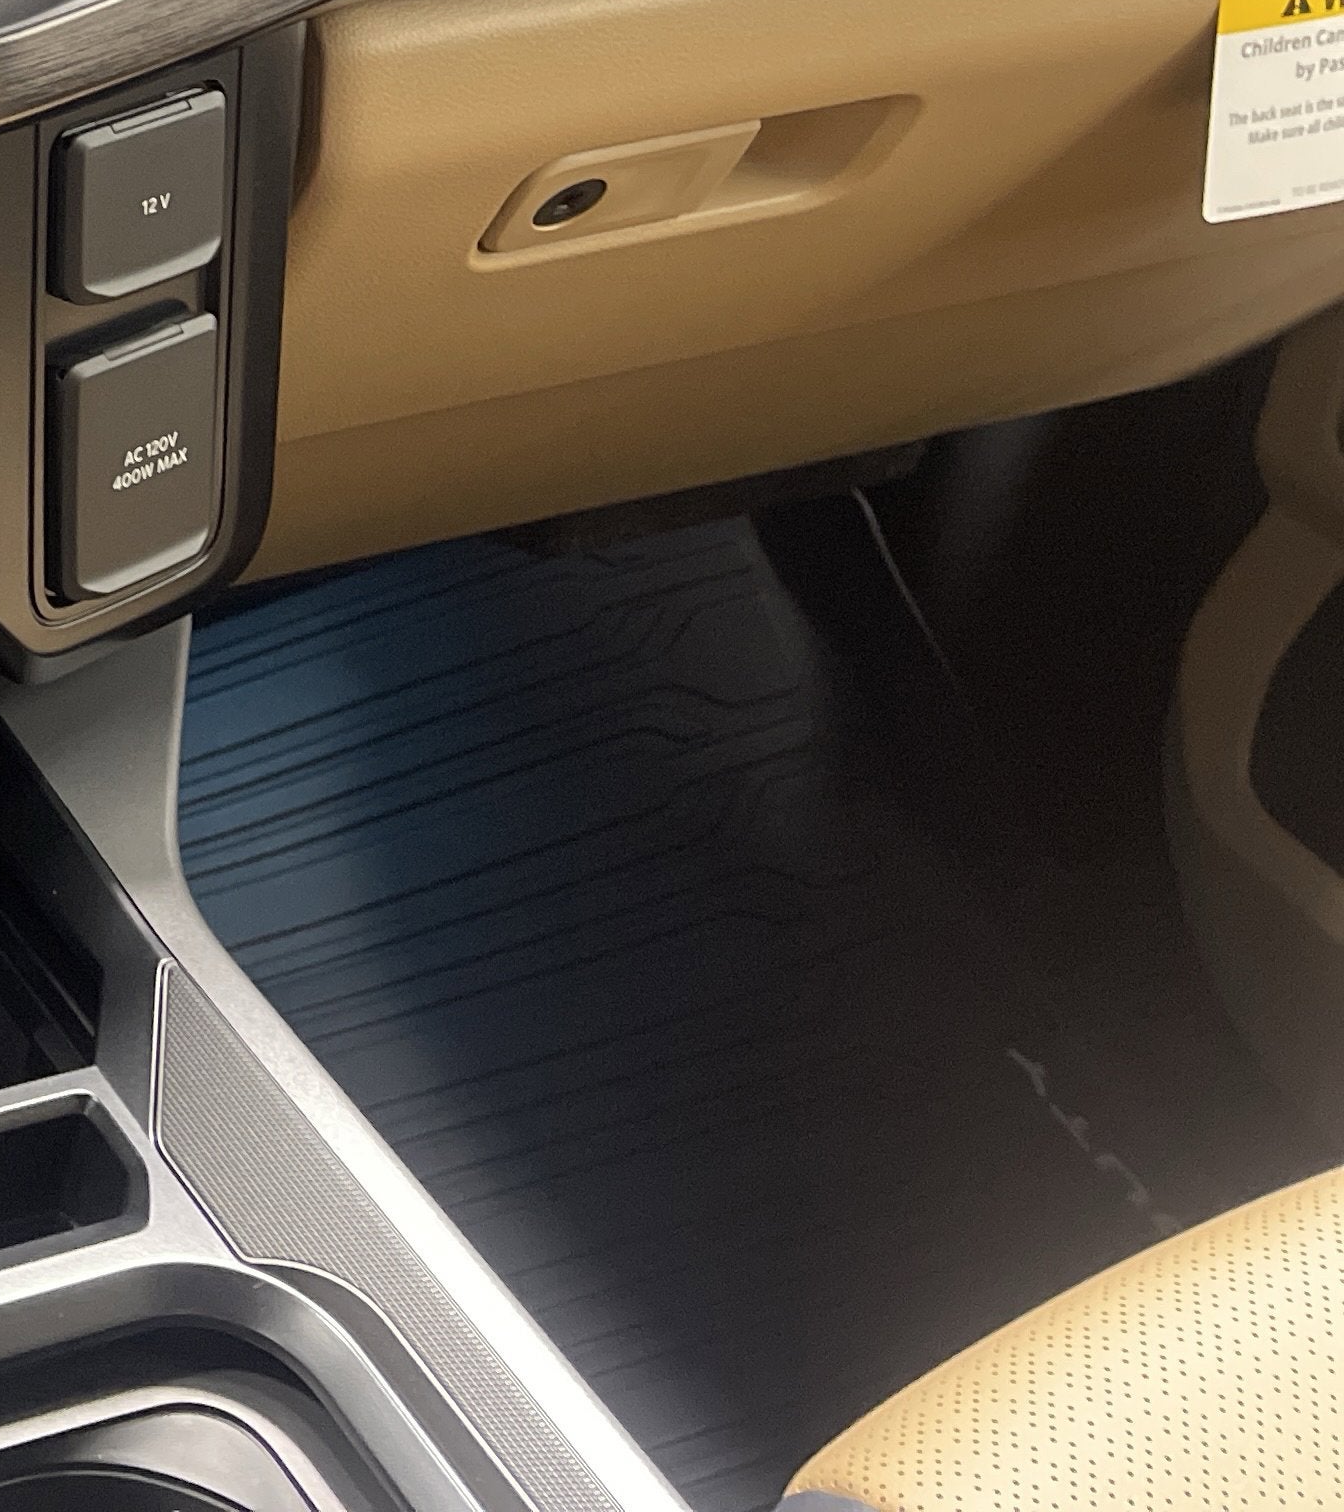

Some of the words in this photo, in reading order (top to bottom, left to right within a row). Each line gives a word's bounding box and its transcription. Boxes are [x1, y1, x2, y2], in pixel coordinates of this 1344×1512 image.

[1241, 34, 1312, 59] Children
[1295, 60, 1315, 82] by
[141, 196, 158, 215] 12
[159, 193, 171, 210] V
[124, 445, 143, 467] AC
[145, 430, 179, 458] 120V
[112, 461, 154, 490] 400W
[156, 446, 188, 474] MAX
